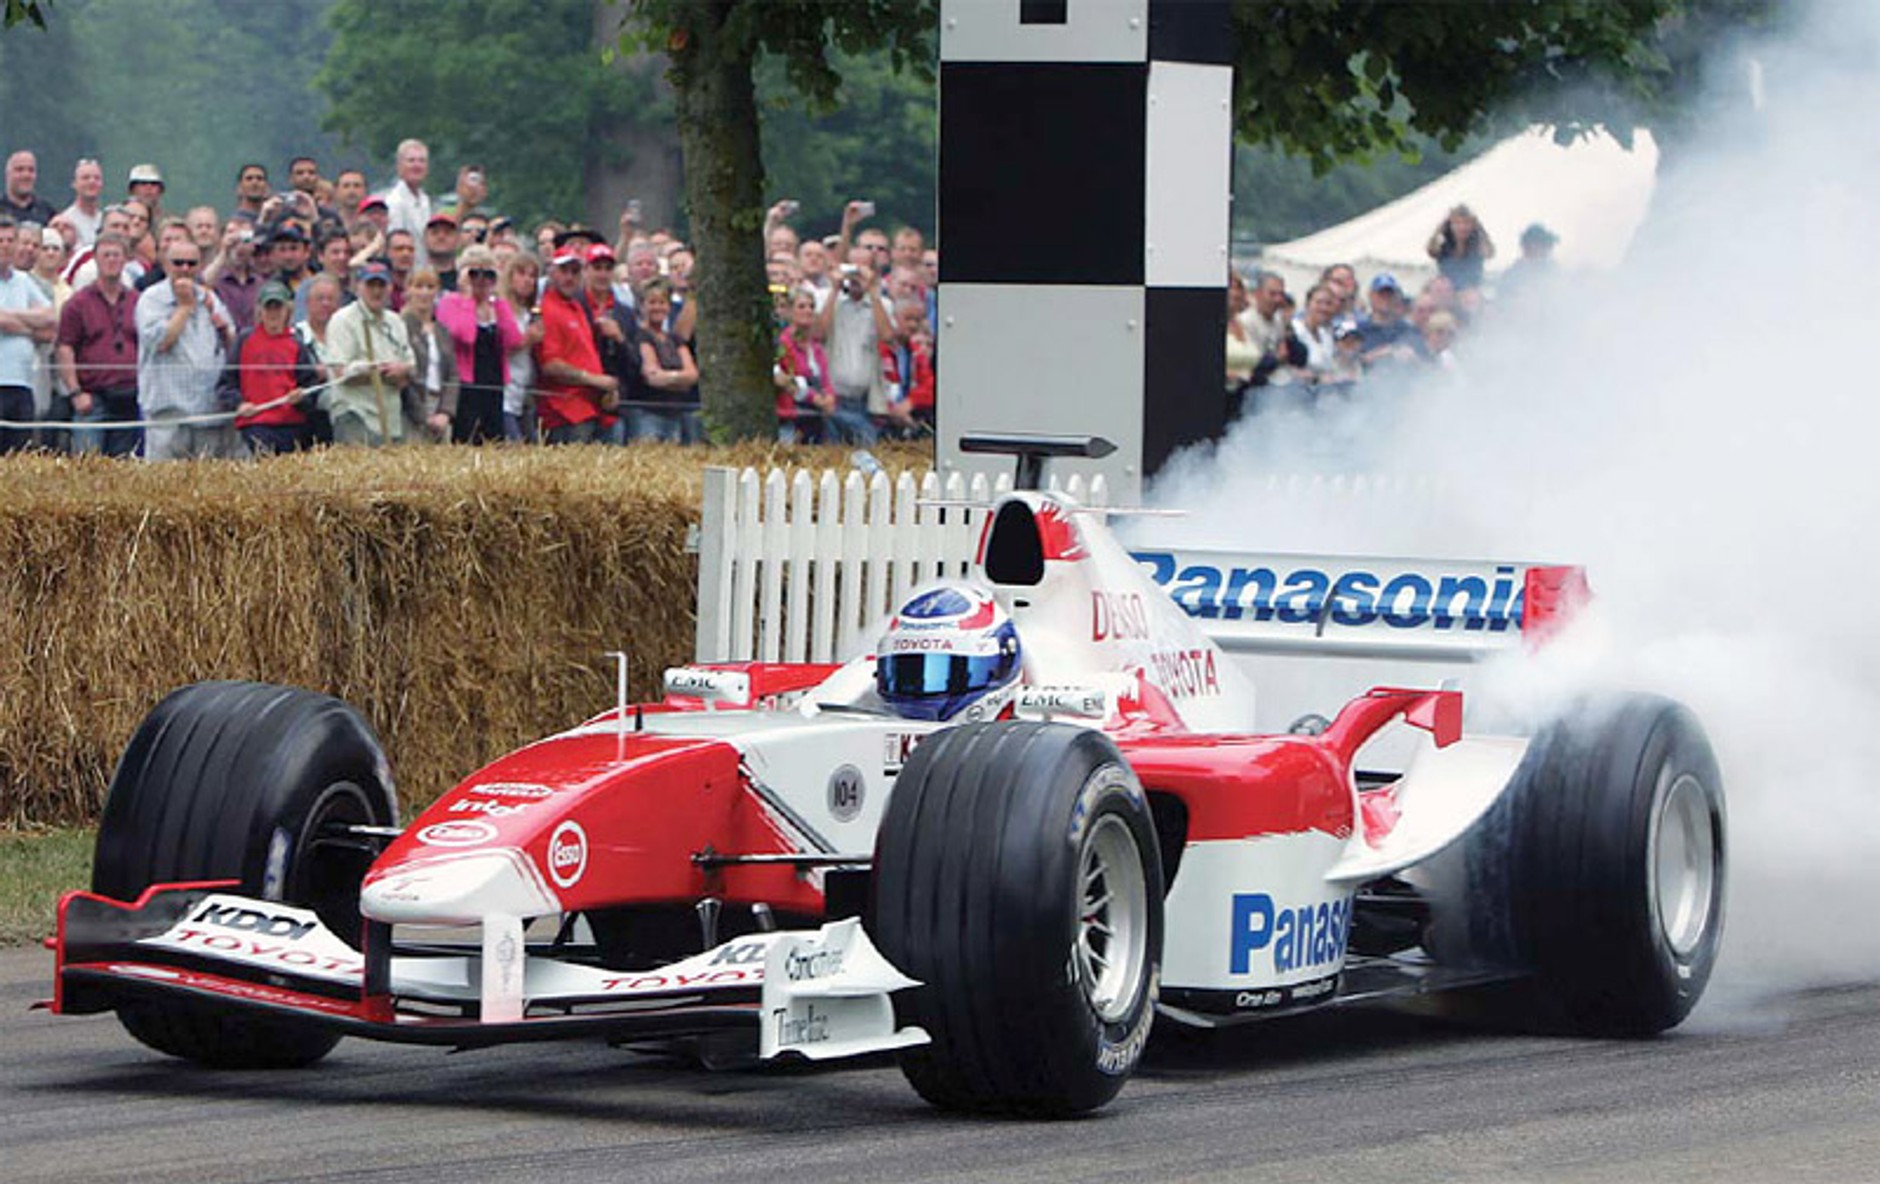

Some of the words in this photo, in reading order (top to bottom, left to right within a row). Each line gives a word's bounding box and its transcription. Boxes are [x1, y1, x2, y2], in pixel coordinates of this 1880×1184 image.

[893, 638, 953, 650] TOYOTA
[834, 778, 857, 807] 104
[554, 840, 580, 867] Esso
[192, 903, 317, 941] KDDI
